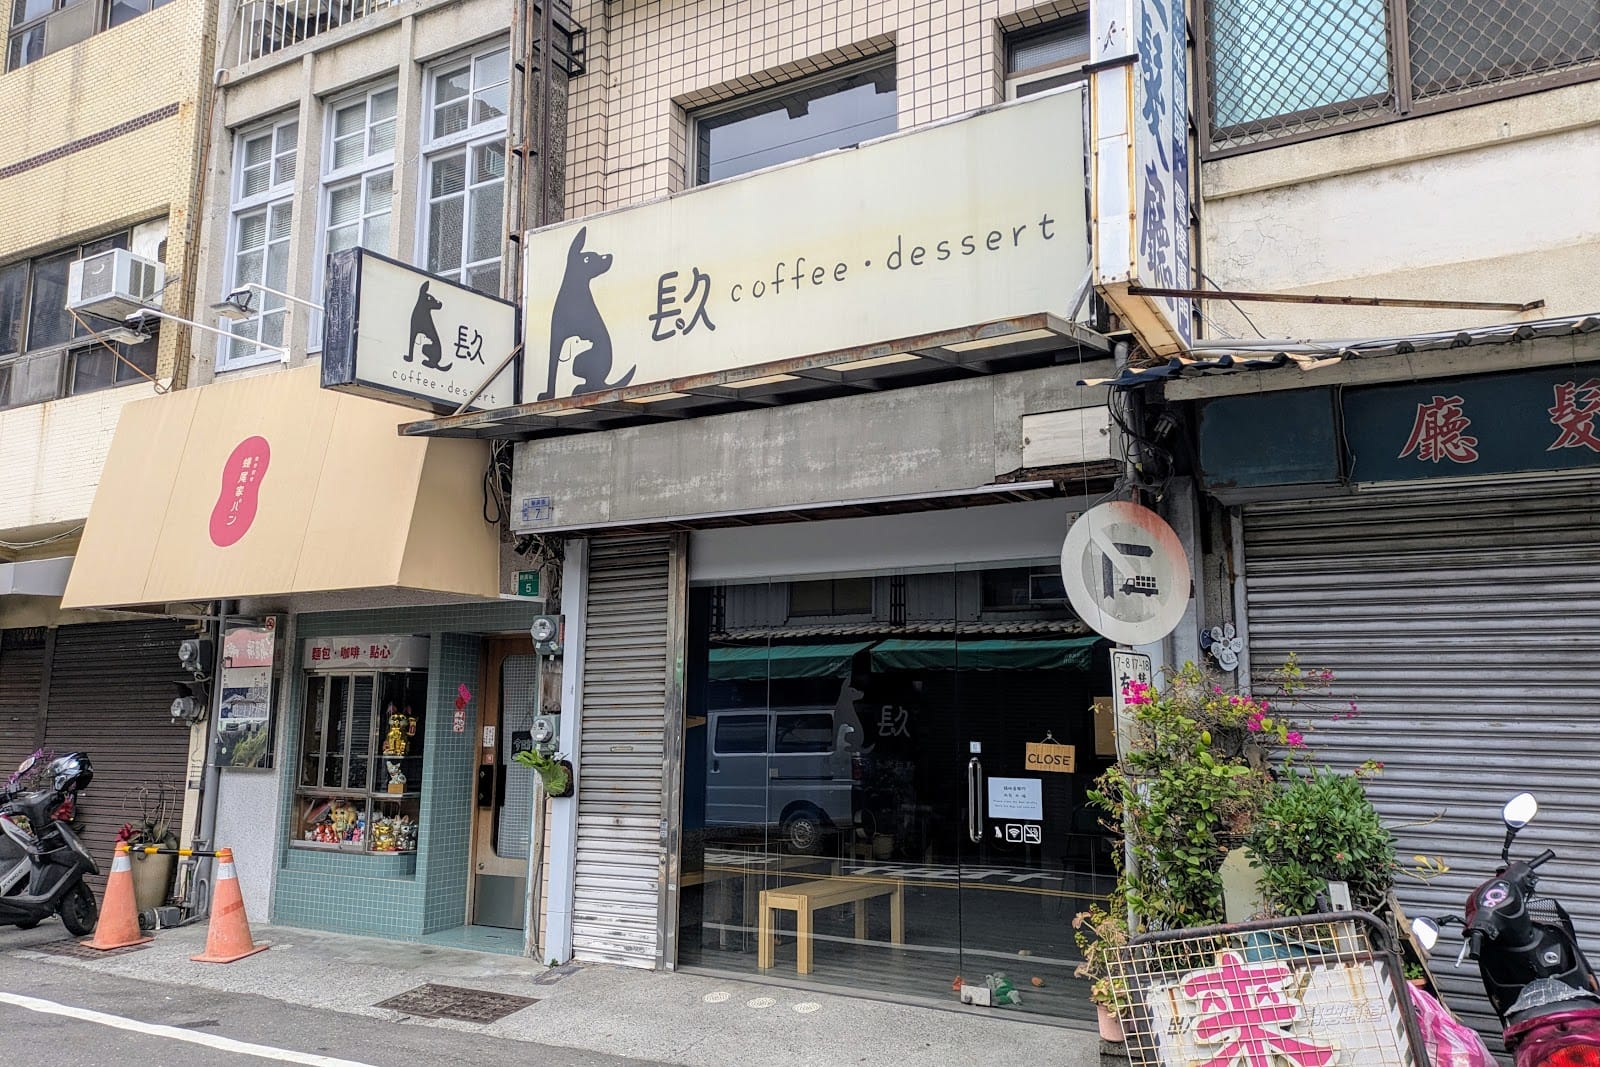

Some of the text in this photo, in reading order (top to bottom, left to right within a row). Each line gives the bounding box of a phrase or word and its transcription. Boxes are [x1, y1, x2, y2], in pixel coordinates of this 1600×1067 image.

[731, 213, 1056, 302] coffee dessert
[392, 370, 436, 389] coffee
[525, 583, 532, 593] 5
[1028, 753, 1072, 766] CLOSE
